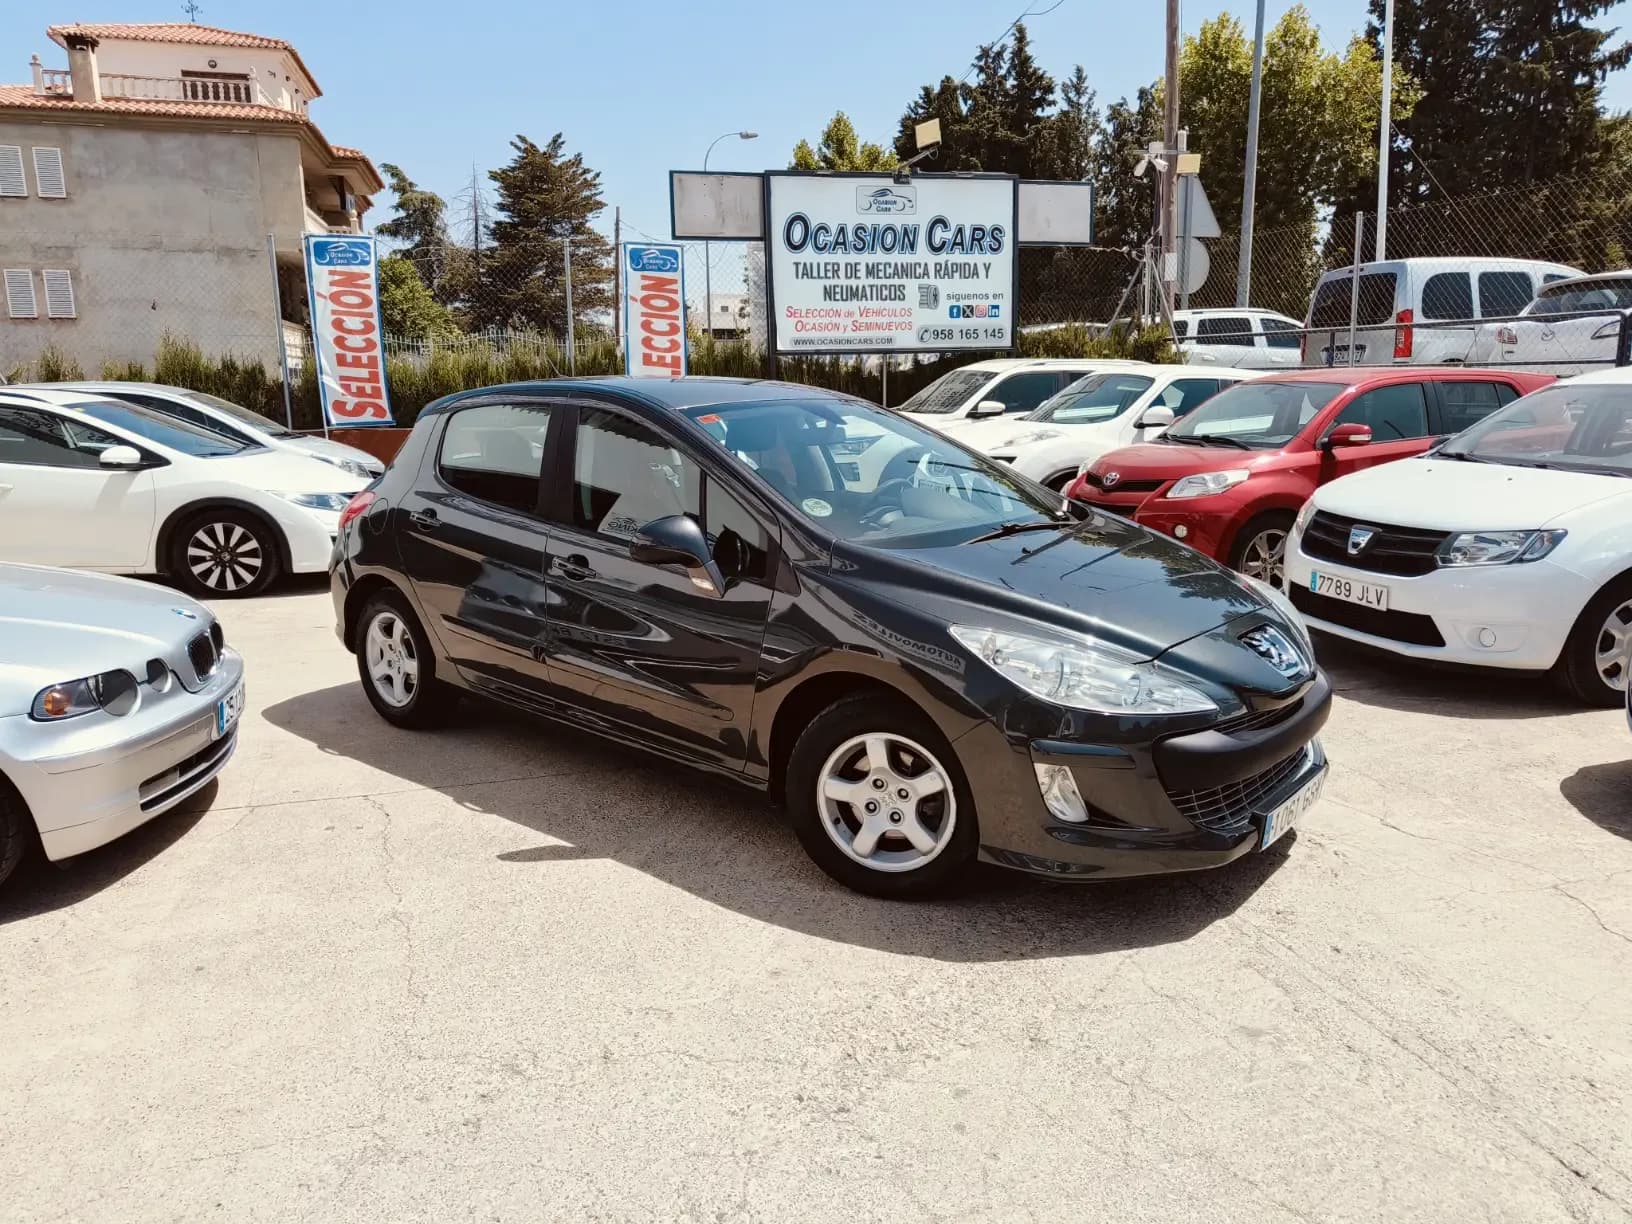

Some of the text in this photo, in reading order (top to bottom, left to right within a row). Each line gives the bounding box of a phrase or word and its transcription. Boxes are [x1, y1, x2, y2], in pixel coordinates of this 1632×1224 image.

[783, 211, 1006, 255] OCASION CARS
[793, 259, 992, 280] TALLER DE MECANICA RÁPIDA Y
[823, 284, 906, 302] NEUMATICOS
[946, 292, 990, 302] siguenos
[844, 308, 855, 318] de
[858, 305, 913, 318] VEHÍCULOS
[851, 319, 913, 332] SEMINUEVOS
[793, 337, 894, 346] WWW.OCASIONCARS.COM
[932, 328, 1005, 340] 958 165 145
[316, 269, 388, 420] SELECCIÓN
[1318, 575, 1384, 606] 7789 JLV
